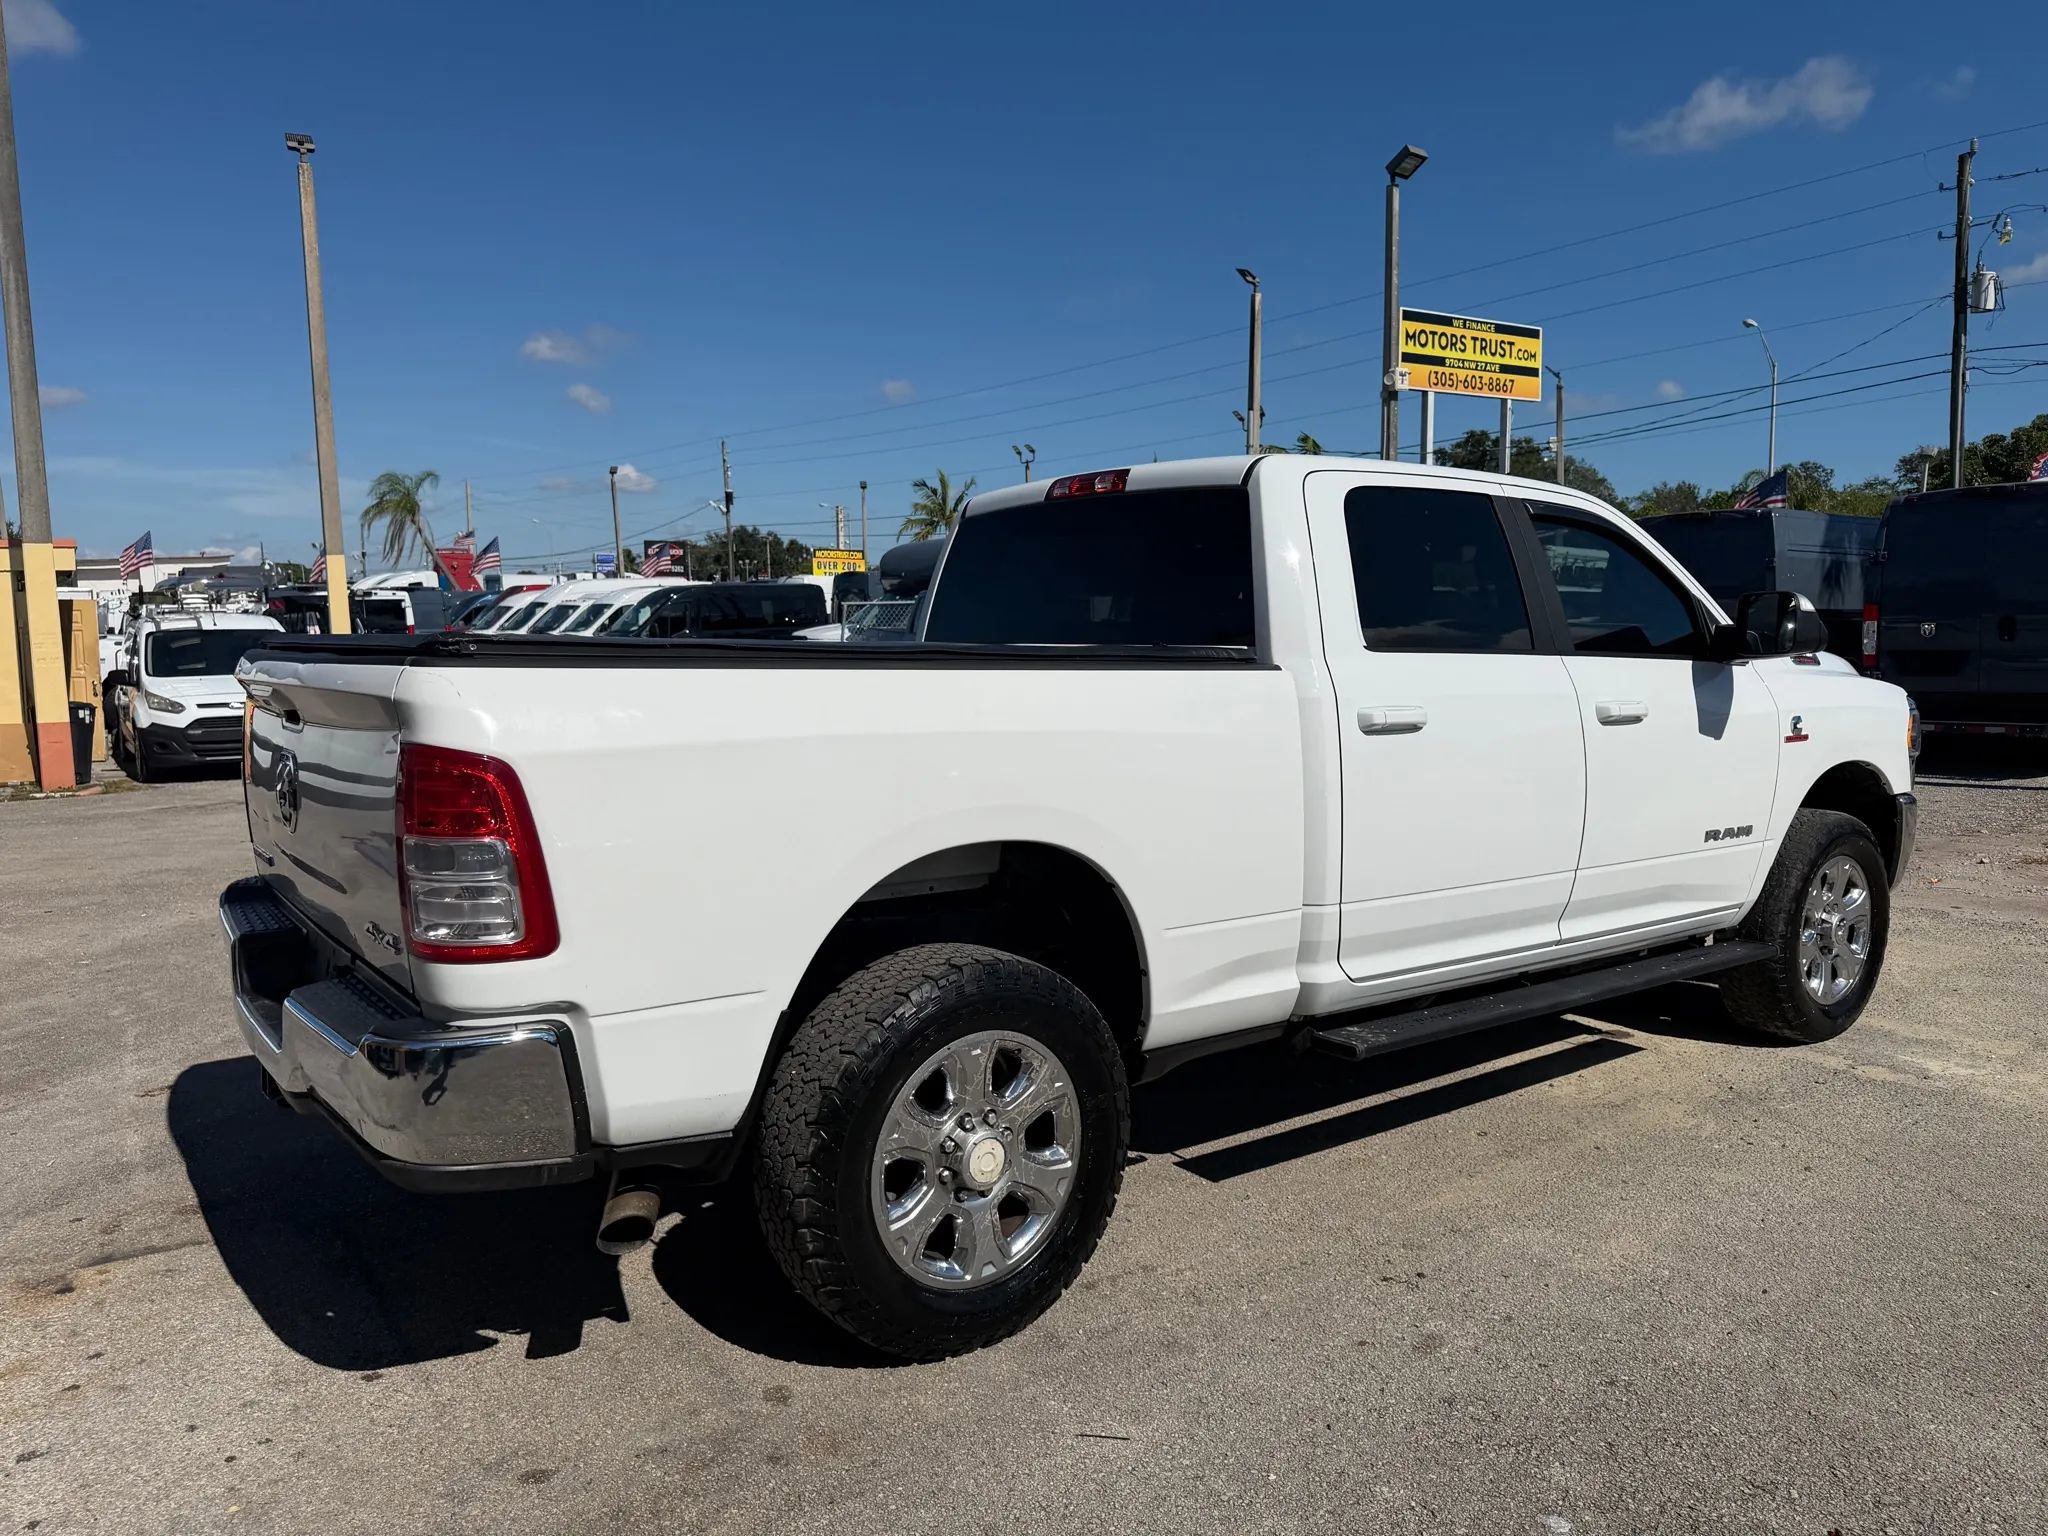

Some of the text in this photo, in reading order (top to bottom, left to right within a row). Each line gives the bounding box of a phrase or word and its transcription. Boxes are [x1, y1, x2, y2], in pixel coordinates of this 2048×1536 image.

[1452, 319, 1496, 333] WE FINANCE
[1405, 327, 1467, 353] MOTORS
[1445, 359, 1500, 372] 9704 NW 27 AVE
[1427, 369, 1515, 394] (305)-603-8867
[816, 560, 838, 570] OVER
[1704, 824, 1753, 843] RAM
